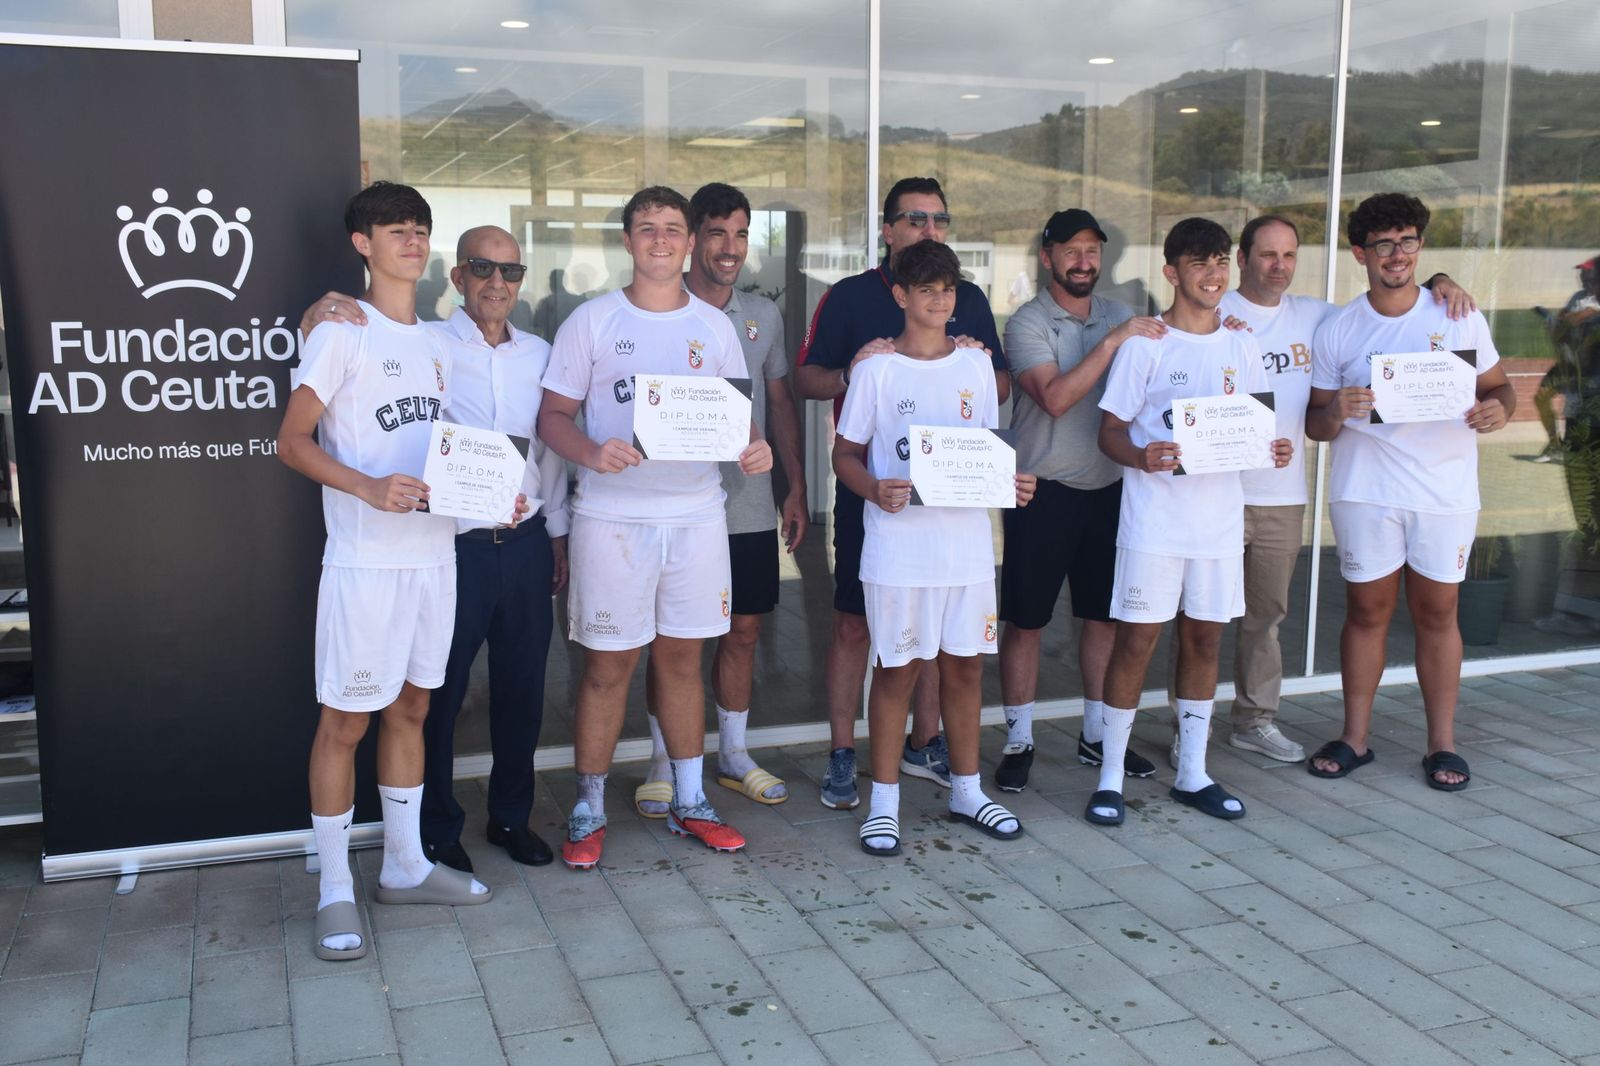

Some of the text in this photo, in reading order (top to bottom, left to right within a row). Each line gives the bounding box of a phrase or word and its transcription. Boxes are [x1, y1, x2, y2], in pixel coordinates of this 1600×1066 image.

[28, 372, 107, 414] AD
[121, 370, 276, 412] Ceuta
[614, 376, 636, 404] C
[1394, 381, 1454, 391] DIPLOMA
[376, 396, 442, 432] CEUT
[660, 411, 728, 421] DIPLOMA
[1196, 426, 1255, 438] DIPLOMA
[84, 443, 153, 461] Mucho
[159, 442, 201, 459] más
[206, 441, 243, 460] que
[446, 462, 504, 479] DIPLOMA
[932, 460, 994, 469] DIPLOMA
